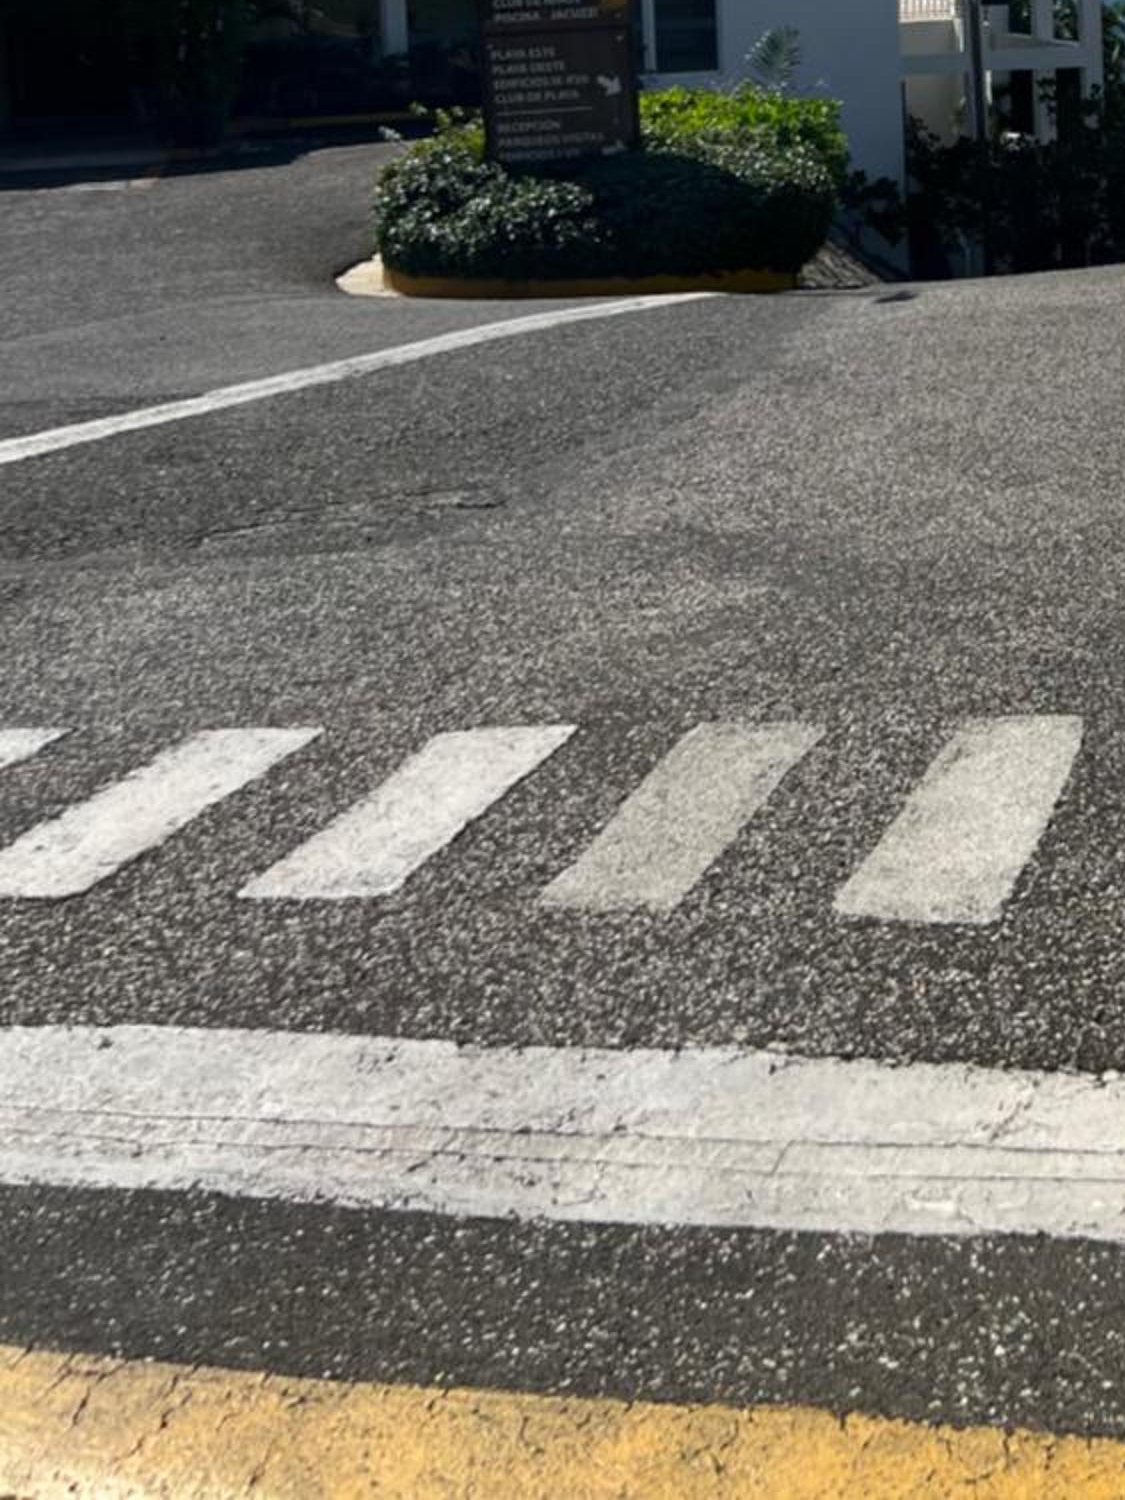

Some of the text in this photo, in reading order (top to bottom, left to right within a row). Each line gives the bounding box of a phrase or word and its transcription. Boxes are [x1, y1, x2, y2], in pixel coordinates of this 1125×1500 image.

[493, 11, 540, 23] PISCINA
[490, 49, 527, 61] PLAYA
[491, 63, 527, 75] PLAYA
[493, 92, 524, 104] CLUB
